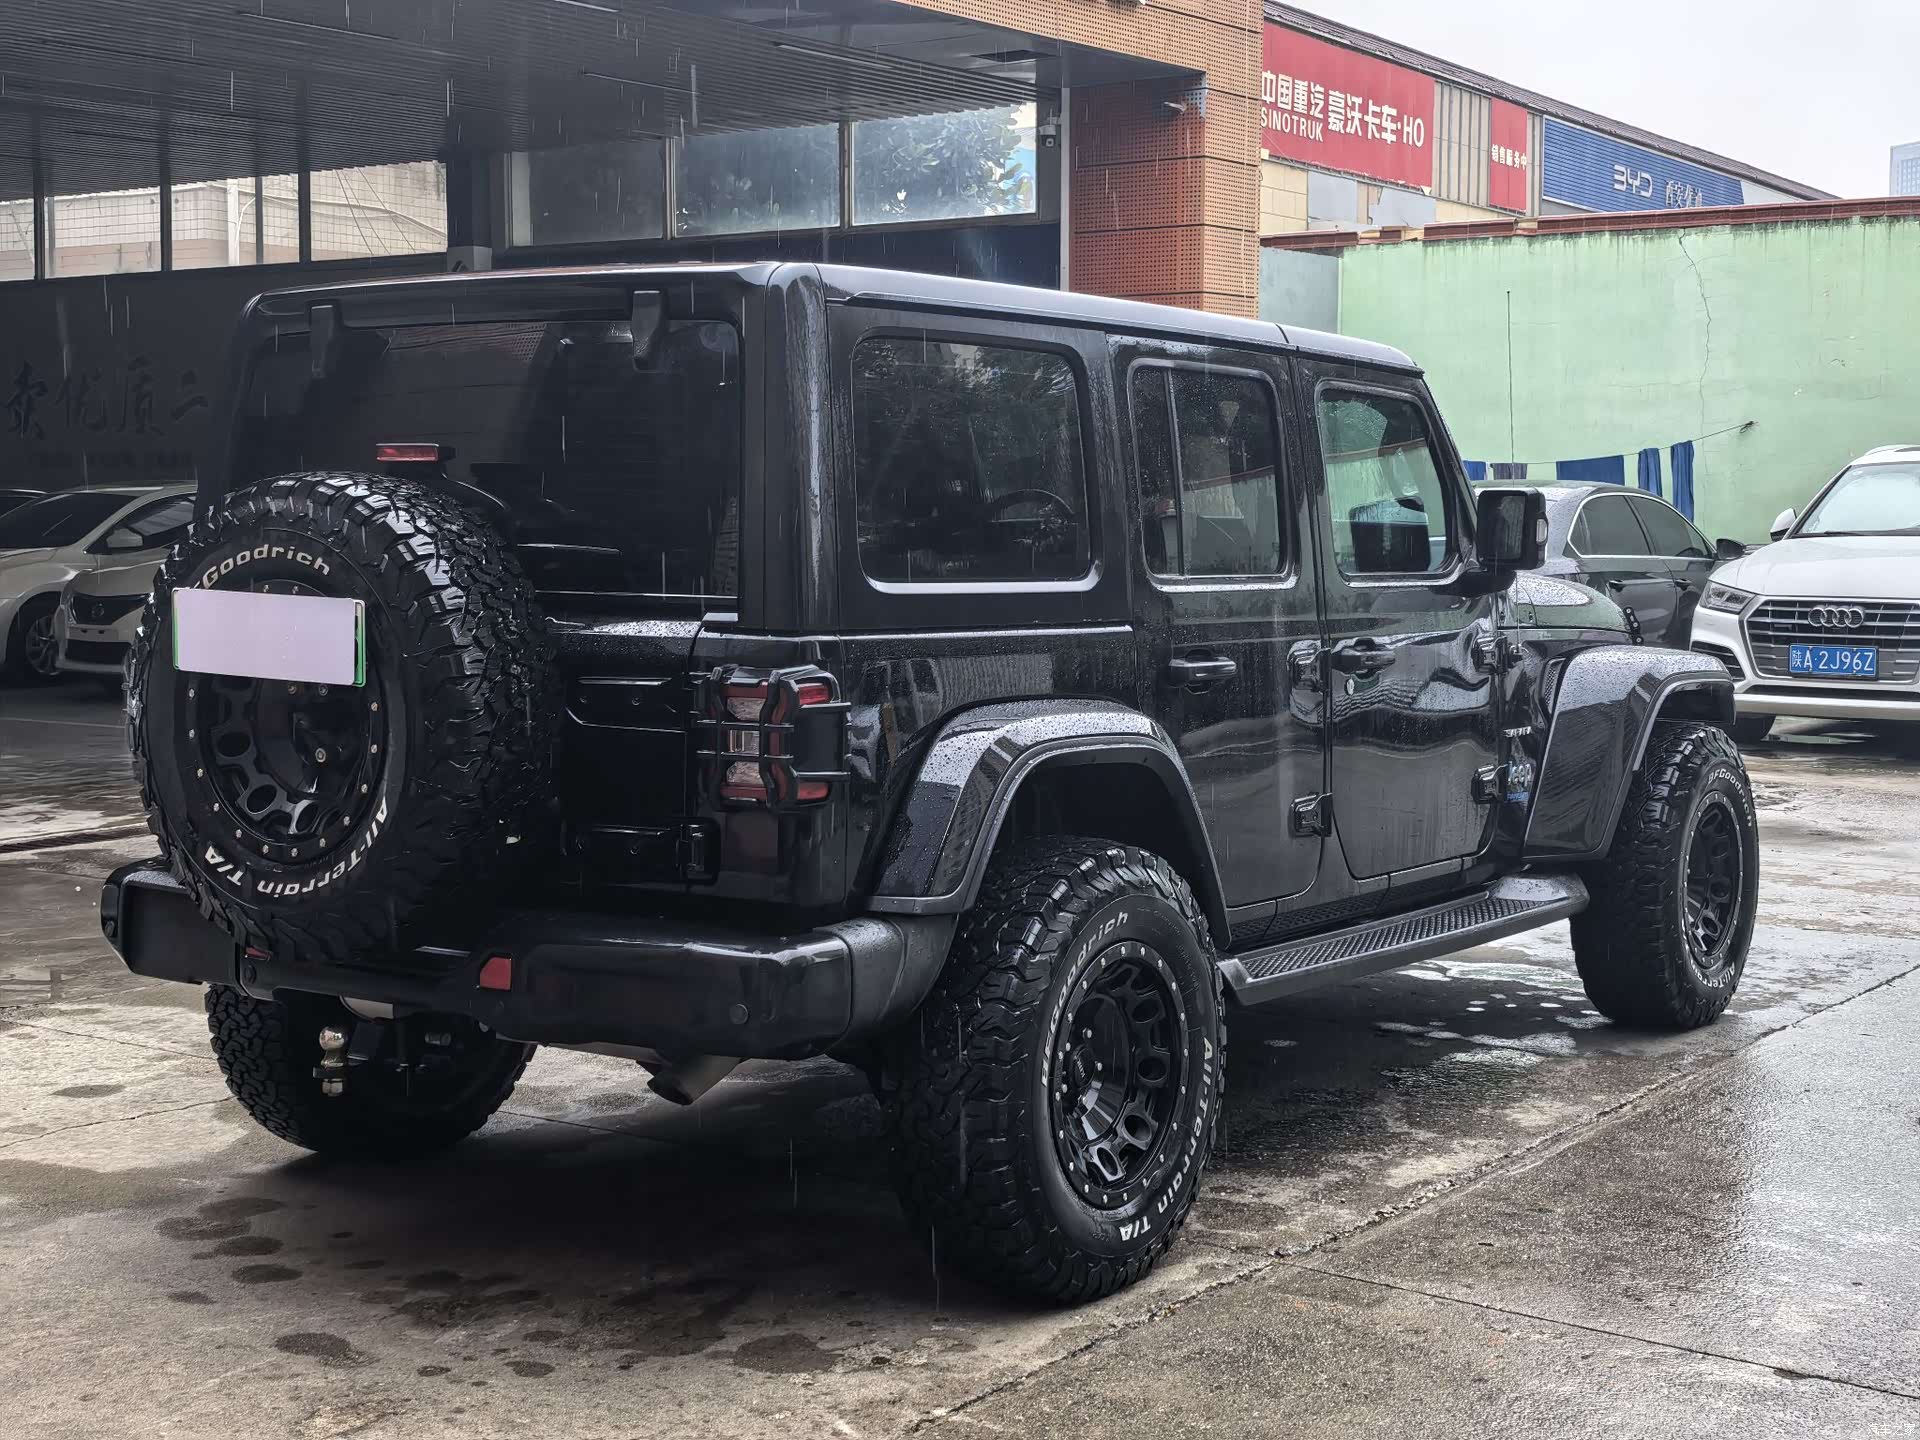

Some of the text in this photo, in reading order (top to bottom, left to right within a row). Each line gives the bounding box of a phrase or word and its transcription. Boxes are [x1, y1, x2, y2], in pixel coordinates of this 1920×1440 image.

[1262, 70, 1325, 119] 中国重汽
[1261, 107, 1324, 142] SINOTRUK
[1614, 164, 1653, 198] BYD
[194, 544, 330, 588] Goodrich
[204, 796, 388, 898] All-Terrain T/A
[1041, 911, 1128, 1087] BFGoodrich
[1119, 1037, 1213, 1241] All-Terrain T/A
